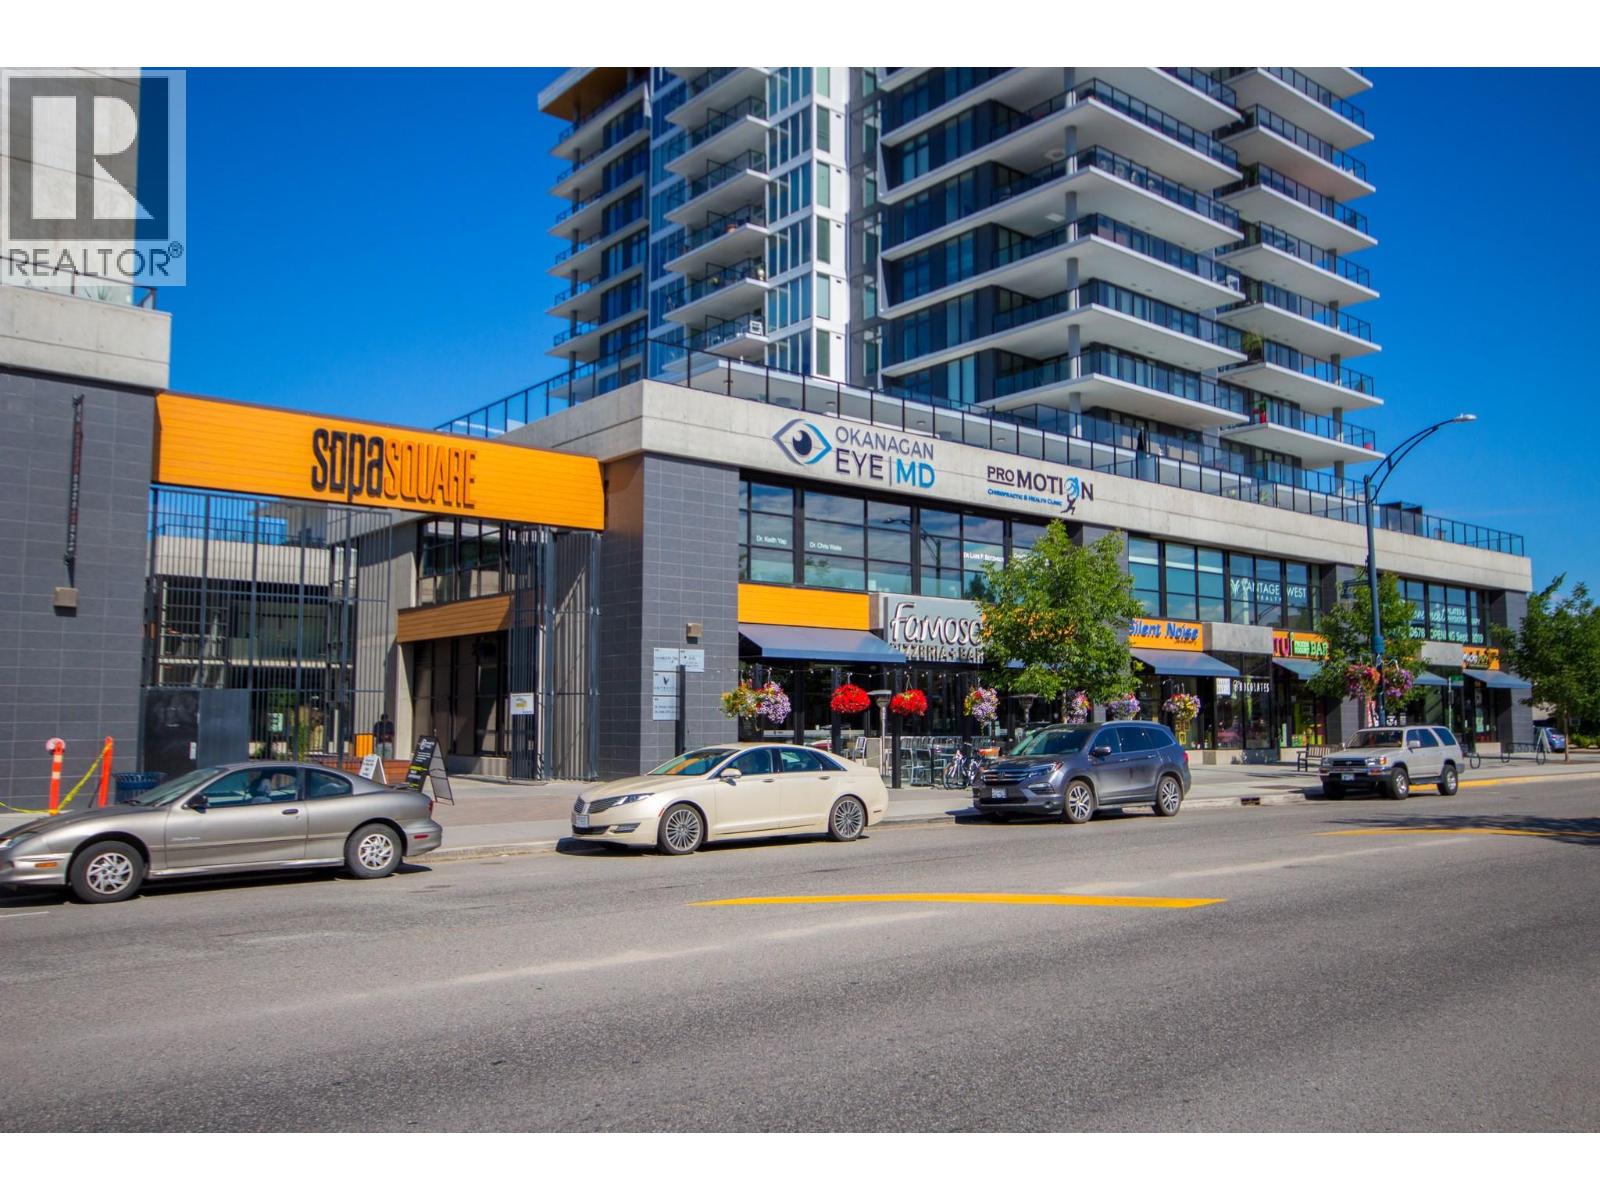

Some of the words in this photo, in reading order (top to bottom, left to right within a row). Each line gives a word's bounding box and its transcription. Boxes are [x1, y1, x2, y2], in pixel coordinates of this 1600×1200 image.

[835, 426, 934, 460] OKANAGAN
[1287, 586, 1307, 599] WEST
[1310, 641, 1329, 656] BAR
